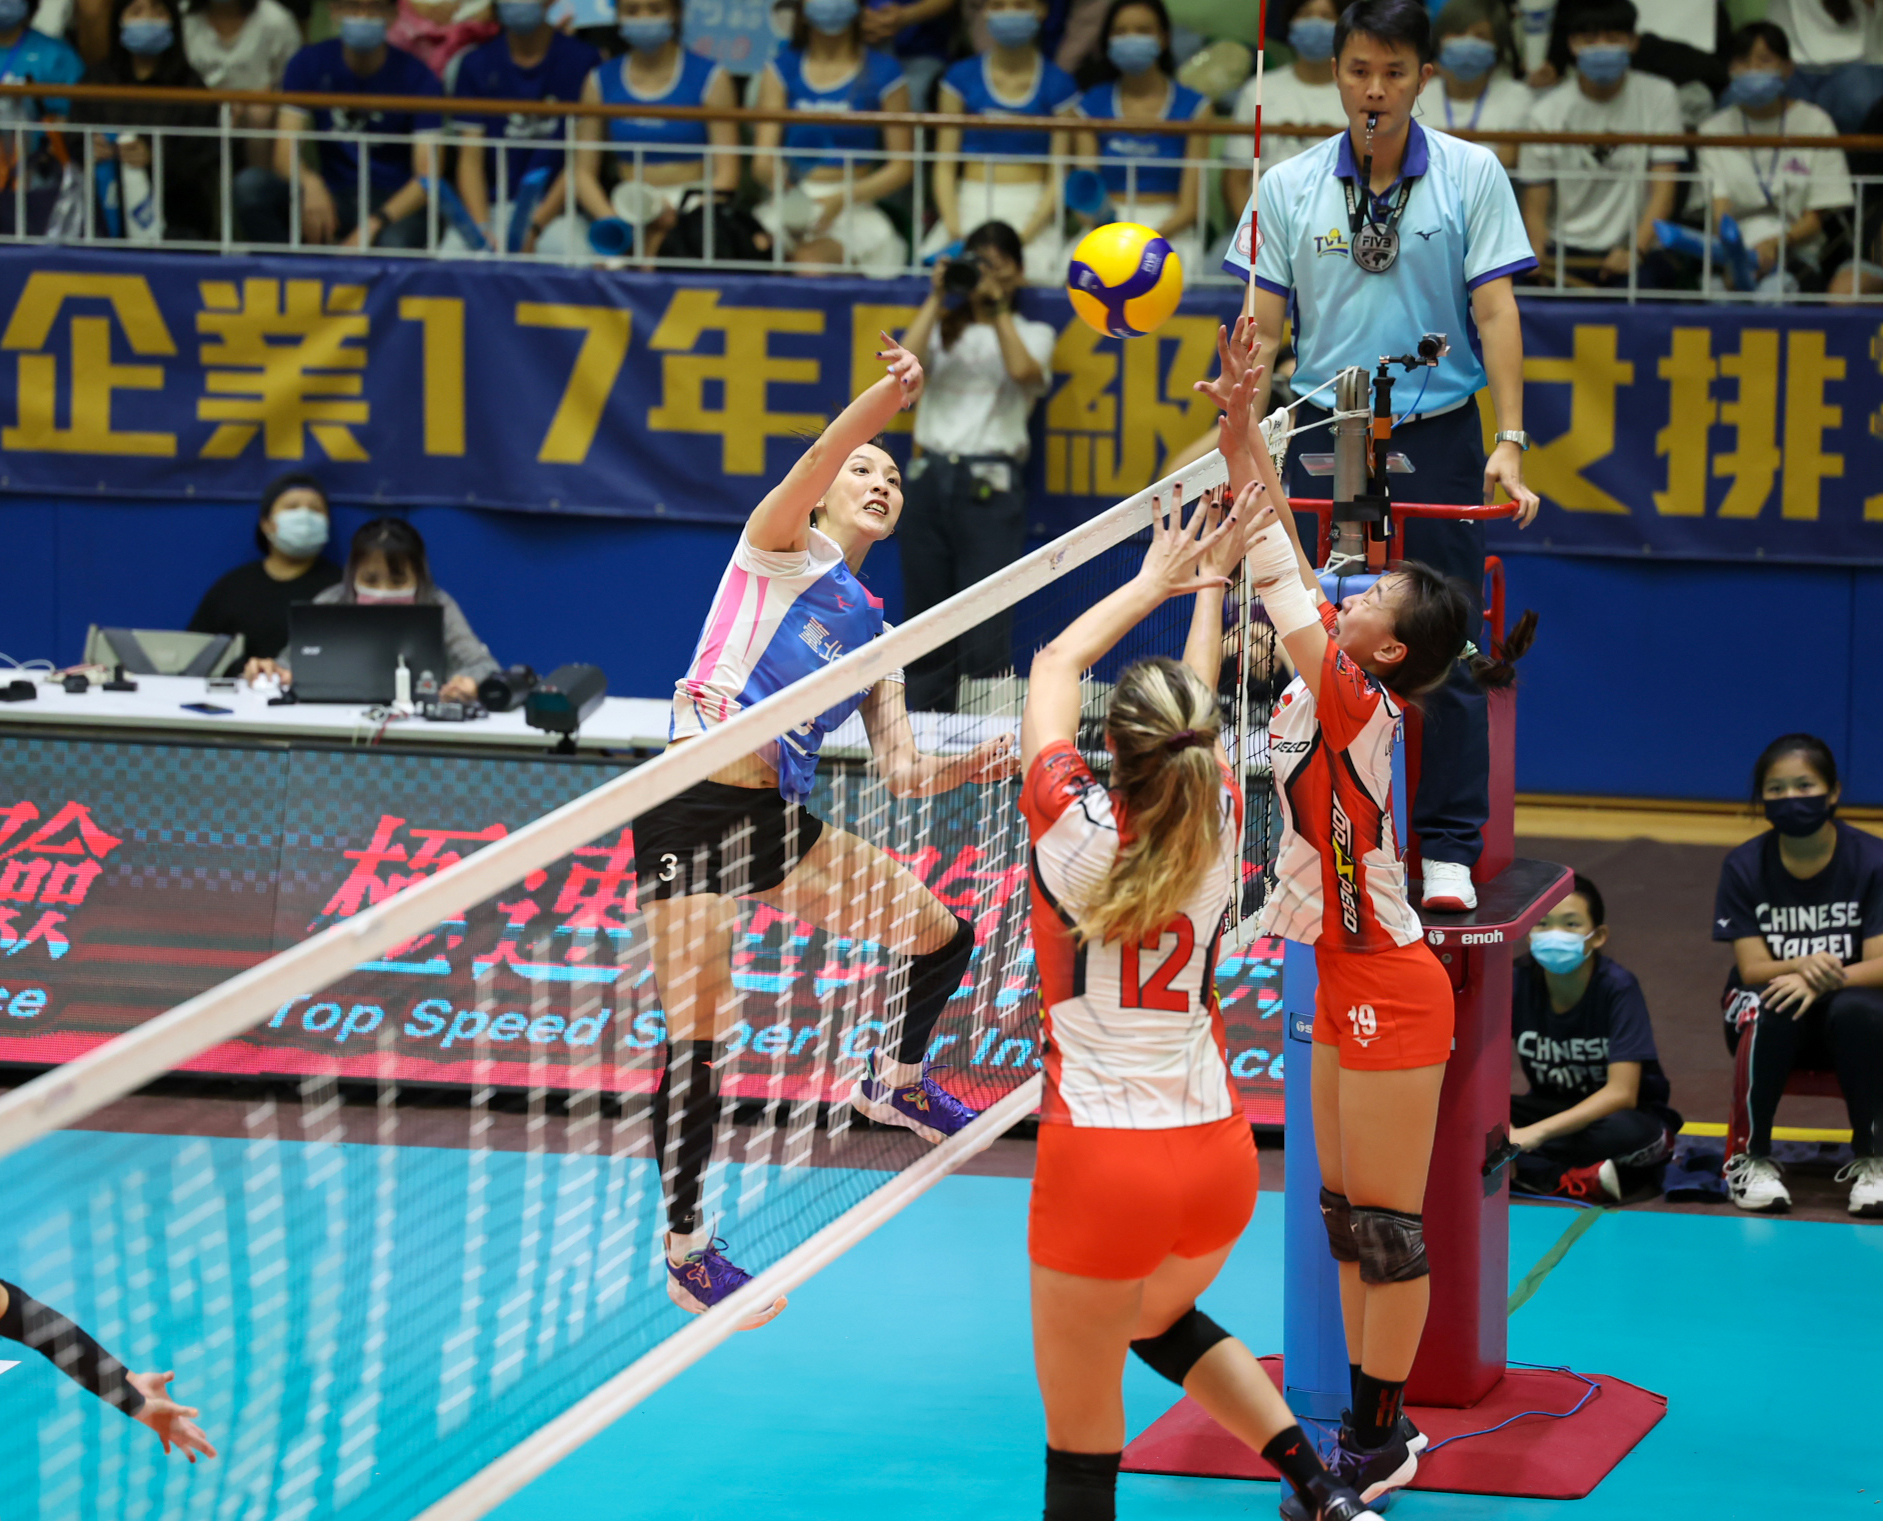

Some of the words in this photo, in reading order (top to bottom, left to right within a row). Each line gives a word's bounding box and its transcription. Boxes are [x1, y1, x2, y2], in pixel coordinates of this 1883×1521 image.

[1362, 235, 1392, 248] FIVB
[658, 852, 678, 882] 3
[1755, 902, 1862, 932] CHINESE
[1102, 911, 1195, 1013] 12
[1766, 934, 1853, 960] TAIPEI
[404, 999, 612, 1047] Speed
[842, 1020, 959, 1064] Cr
[1347, 1004, 1378, 1036] 19
[1517, 1030, 1610, 1063] CHNESE
